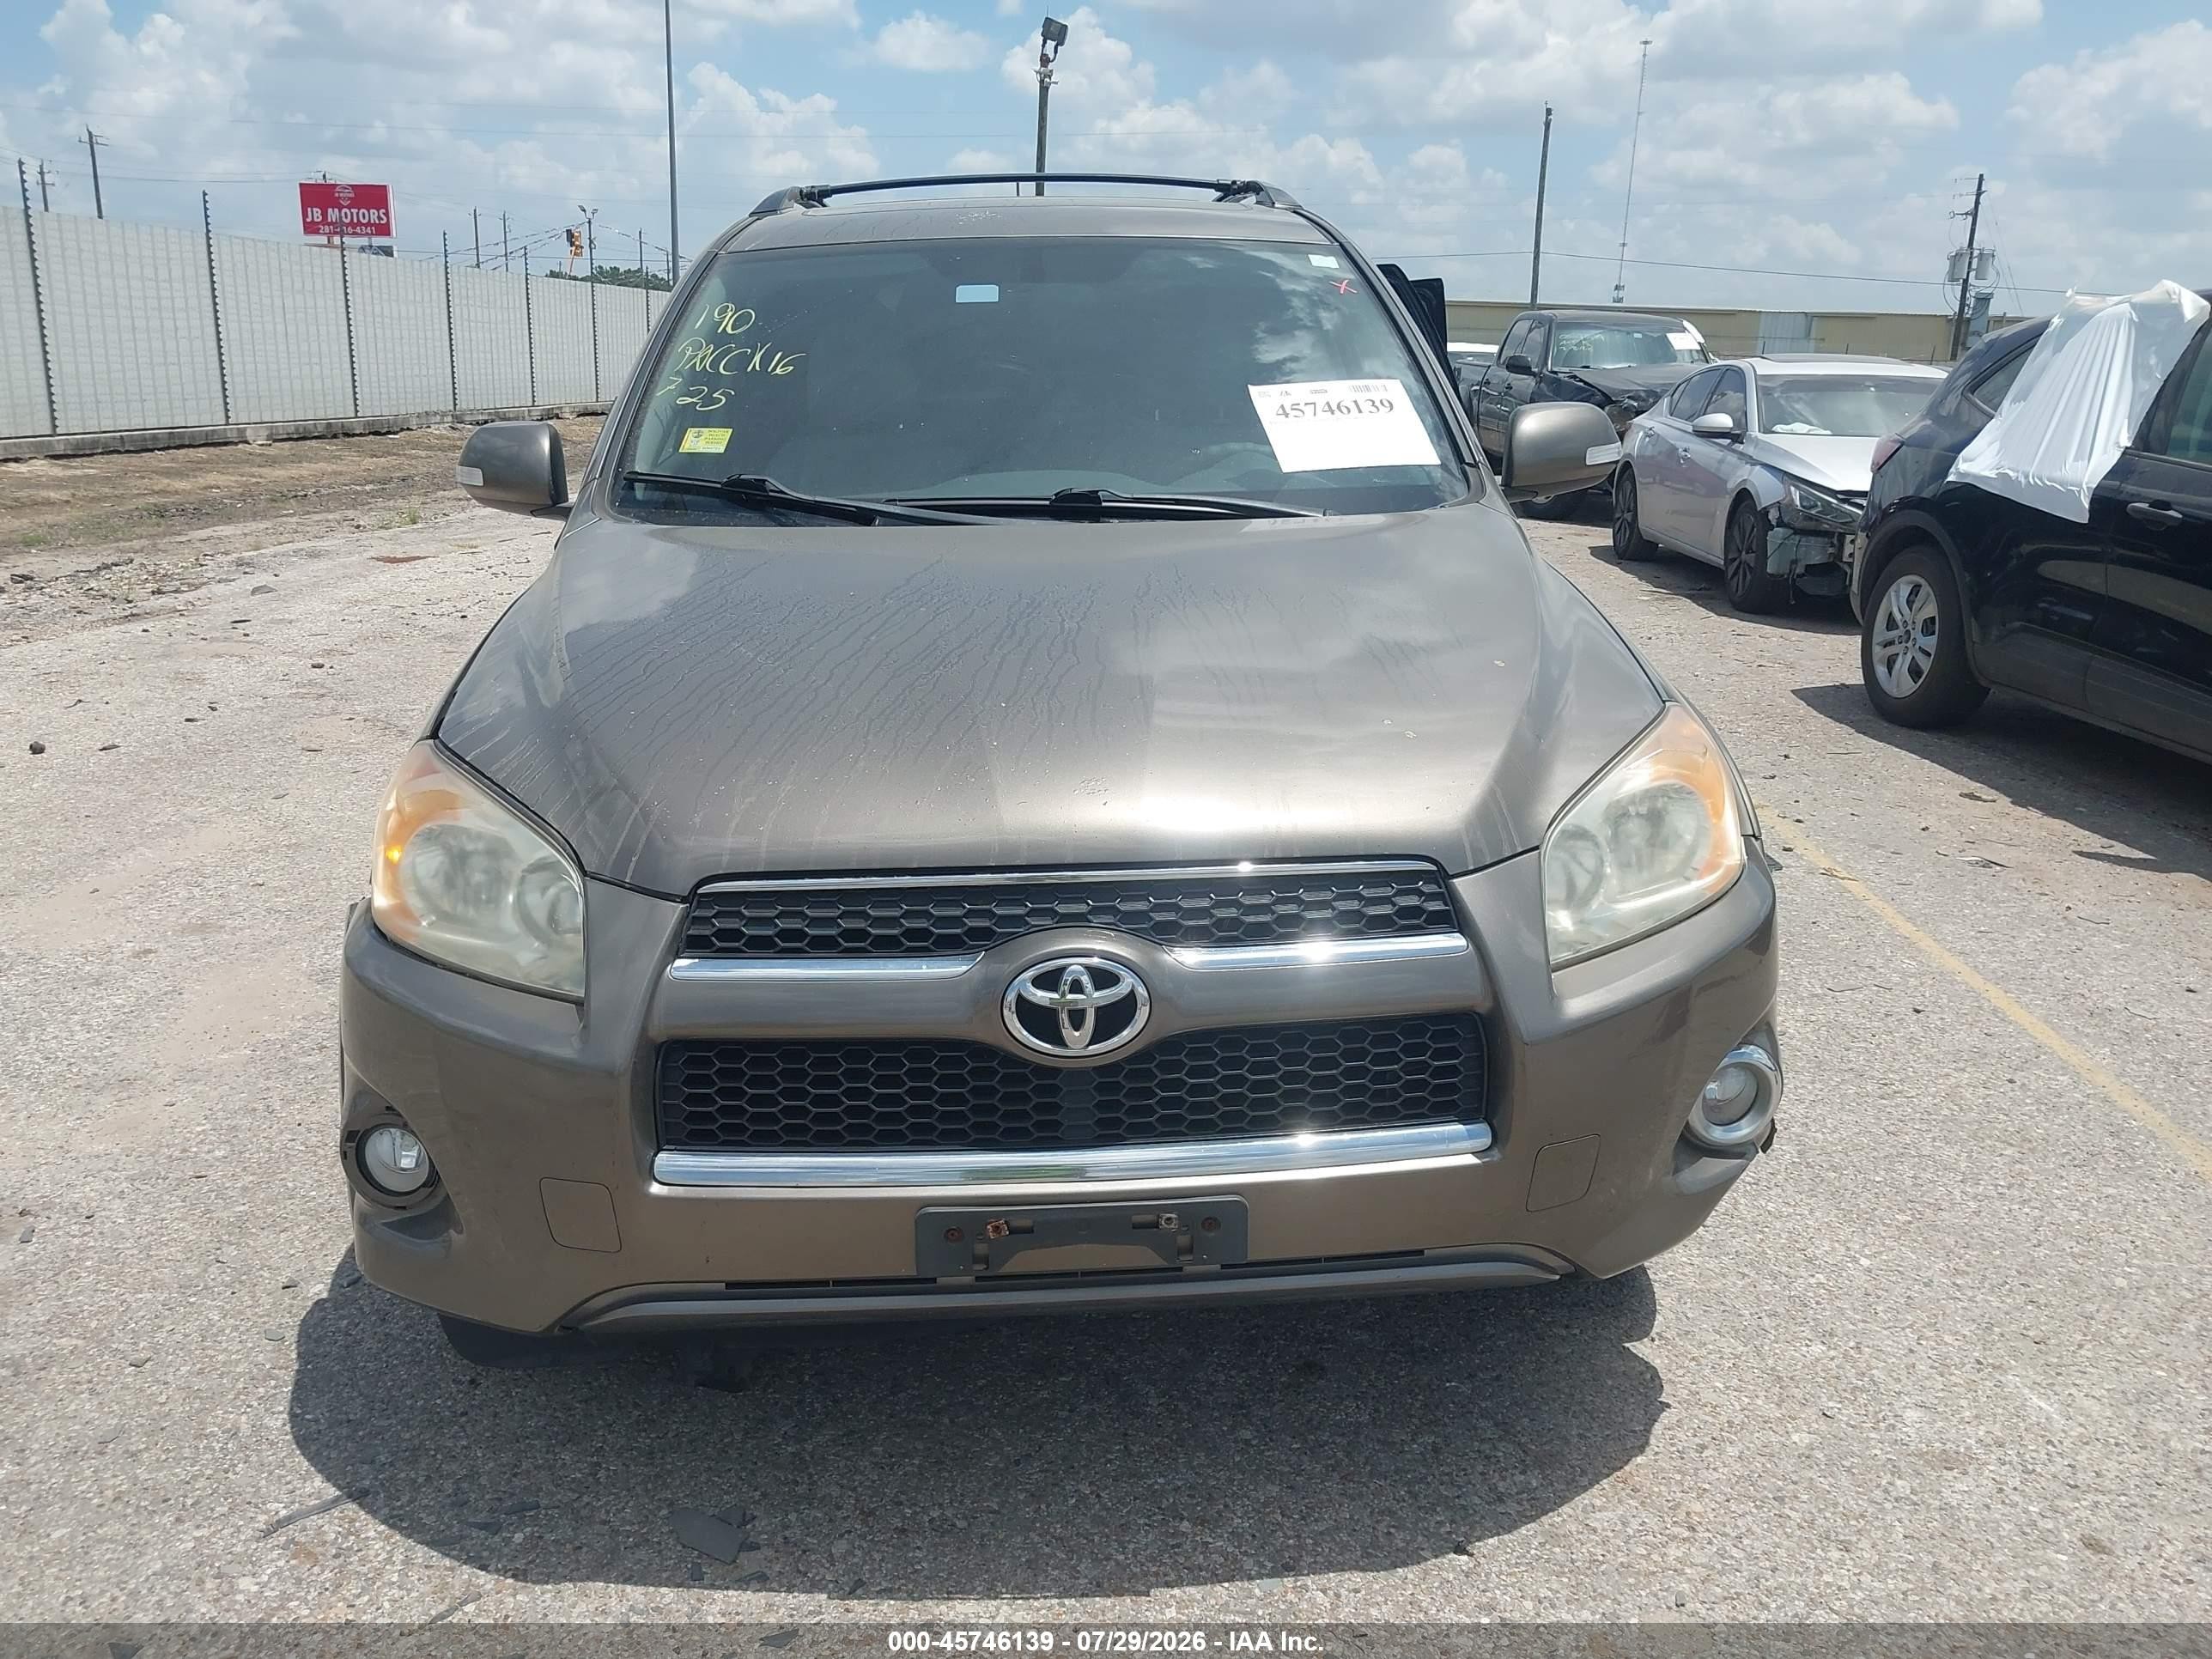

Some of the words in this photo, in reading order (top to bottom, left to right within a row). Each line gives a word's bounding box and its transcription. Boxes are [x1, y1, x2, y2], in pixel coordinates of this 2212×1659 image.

[306, 208, 322, 222] JB
[327, 208, 387, 223] MOTORS
[319, 225, 376, 234] 281-16-4341
[695, 302, 756, 334] 190
[1276, 398, 1394, 418] 45746139
